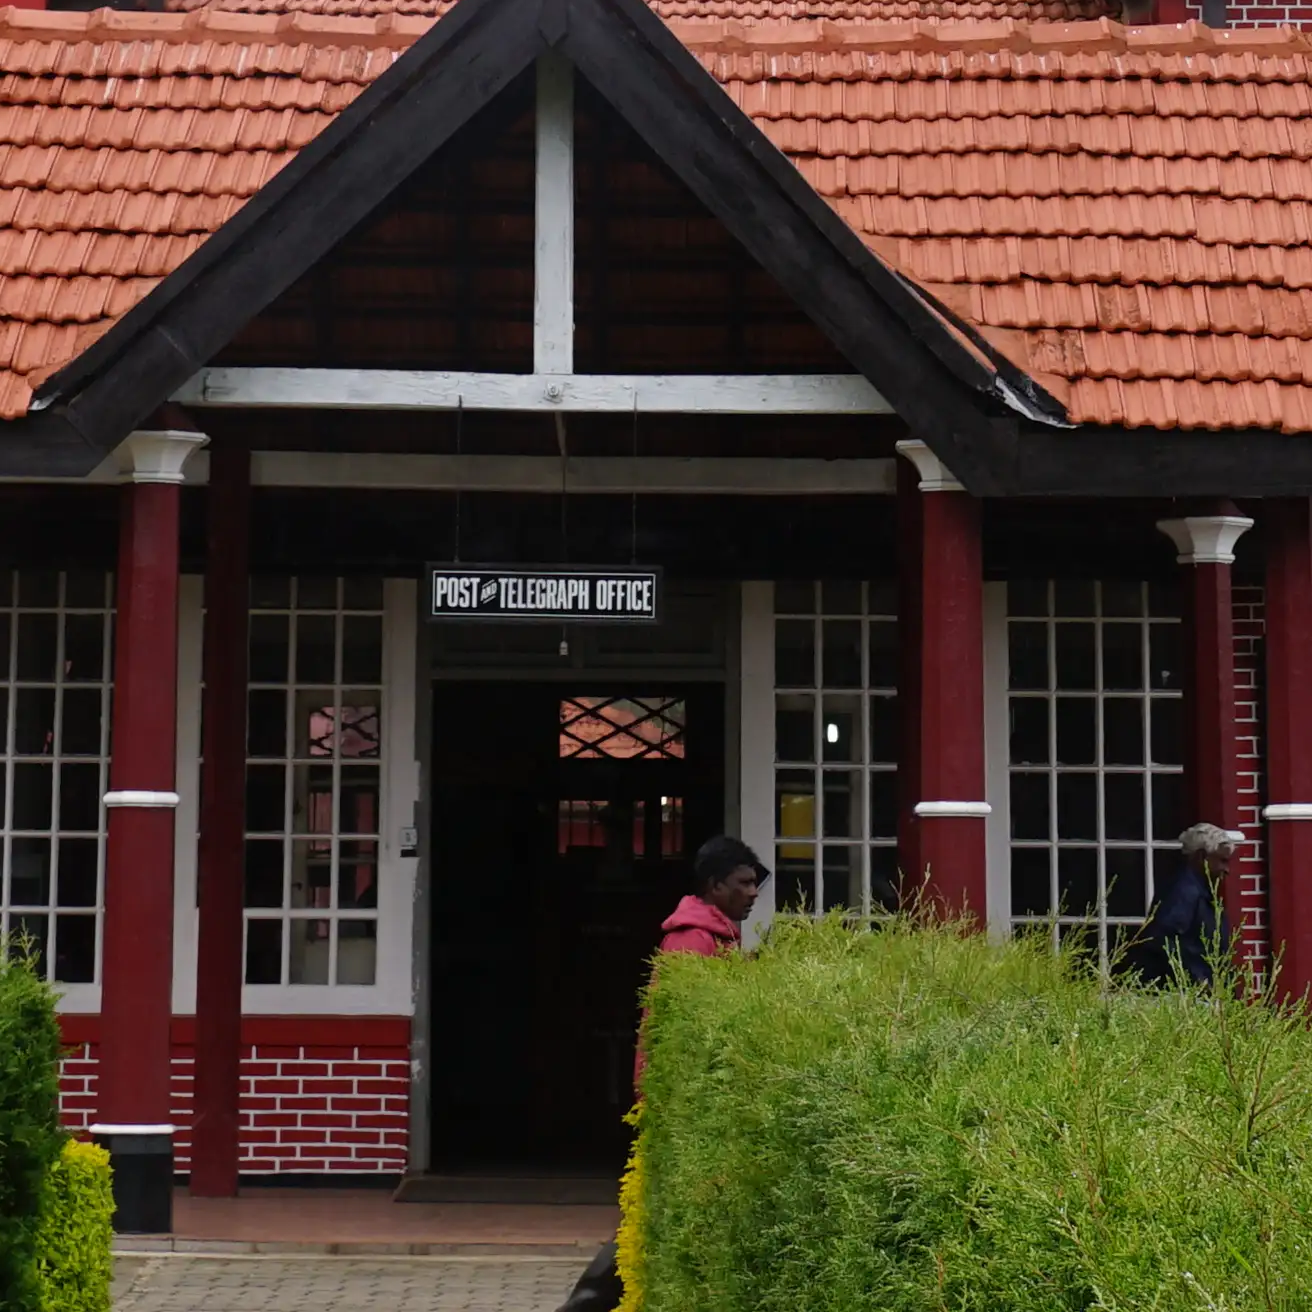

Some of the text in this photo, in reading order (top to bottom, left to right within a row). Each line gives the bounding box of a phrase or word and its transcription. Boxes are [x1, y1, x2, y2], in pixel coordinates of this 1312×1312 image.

[436, 577, 652, 611] POST AND TELEGRAPH OFFICE
